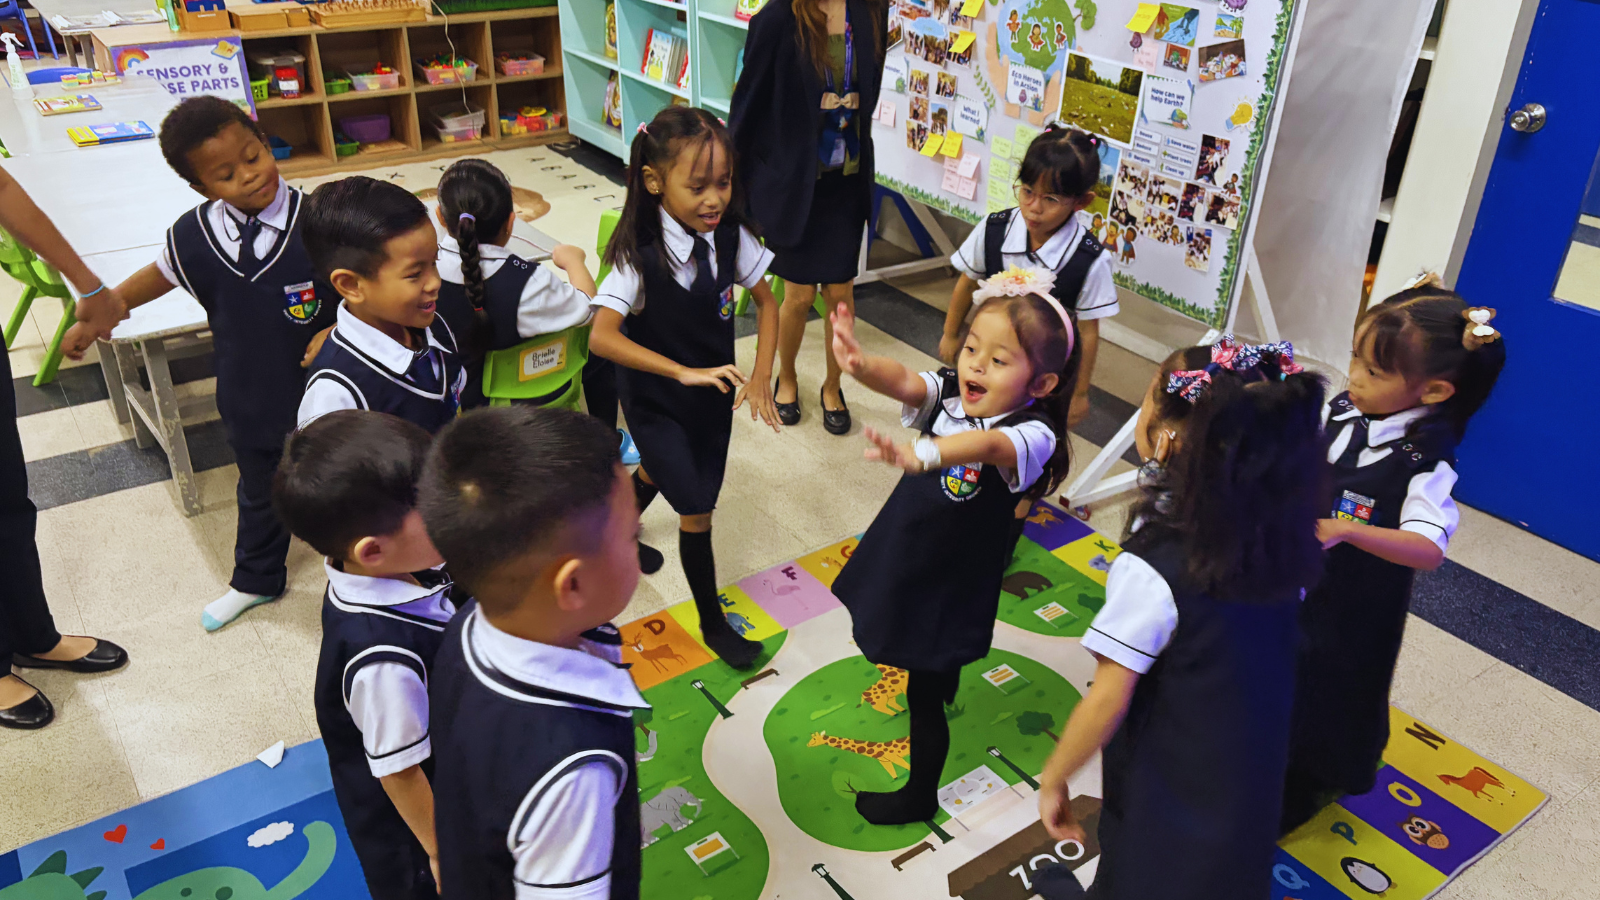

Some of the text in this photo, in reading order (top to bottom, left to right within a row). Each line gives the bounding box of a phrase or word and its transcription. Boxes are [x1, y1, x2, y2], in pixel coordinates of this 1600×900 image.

[218, 63, 229, 75] &
[191, 77, 240, 93] PARTS
[1011, 70, 1042, 87] Eco Heroes
[1020, 81, 1038, 92] Action
[1151, 87, 1164, 96] How
[1164, 90, 1175, 98] can
[1151, 94, 1183, 108] help Earth?
[963, 105, 975, 116] What
[960, 112, 980, 125] learned
[1182, 142, 1196, 151] water
[532, 347, 556, 362] Brielle
[532, 357, 555, 369] Eloise
[840, 544, 857, 559] G
[1094, 540, 1115, 552] K
[781, 566, 798, 580] F
[717, 593, 736, 607] E
[643, 619, 666, 635] D
[1405, 721, 1446, 751] N
[1388, 781, 1422, 808] O
[1330, 821, 1358, 846] P
[1272, 863, 1311, 890] Q
